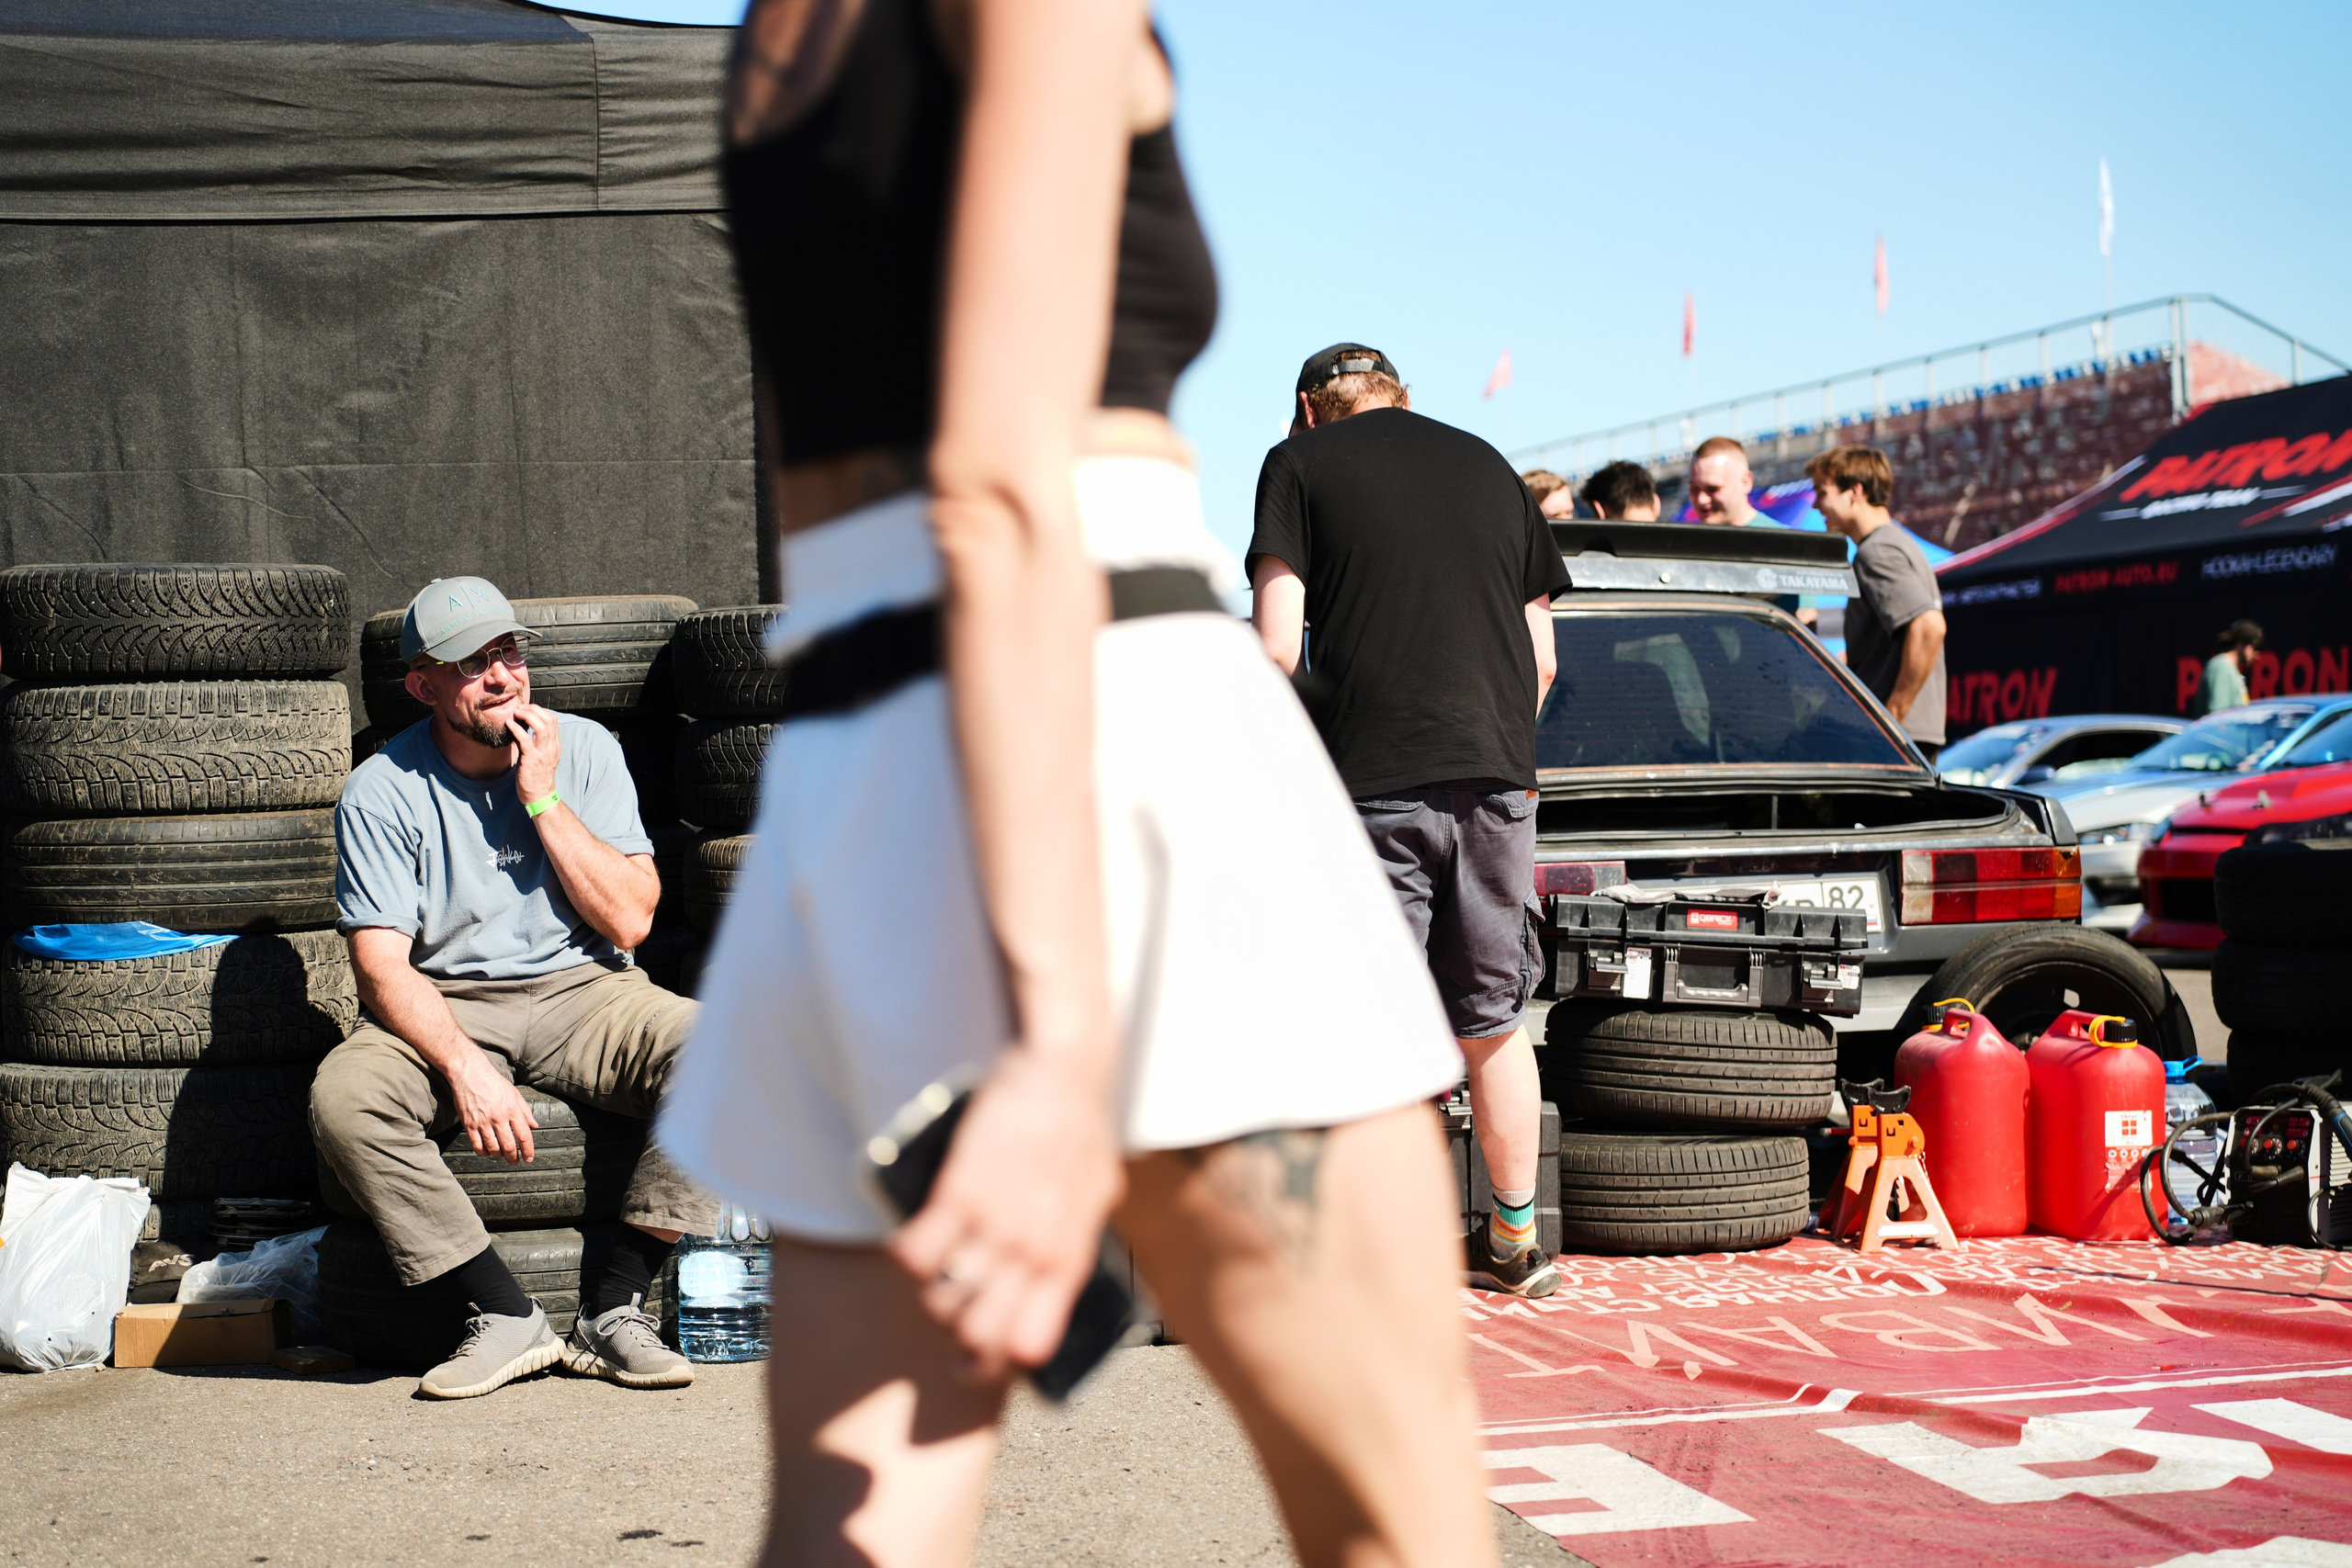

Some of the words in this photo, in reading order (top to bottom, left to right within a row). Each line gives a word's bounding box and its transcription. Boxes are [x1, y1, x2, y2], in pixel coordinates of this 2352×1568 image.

[1779, 574, 1849, 591] TAKAYAMA
[2177, 645, 2349, 713] PRON
[1946, 667, 2057, 725] ATRON
[1828, 886, 1864, 908] 82
[149, 1254, 195, 1272] AVS
